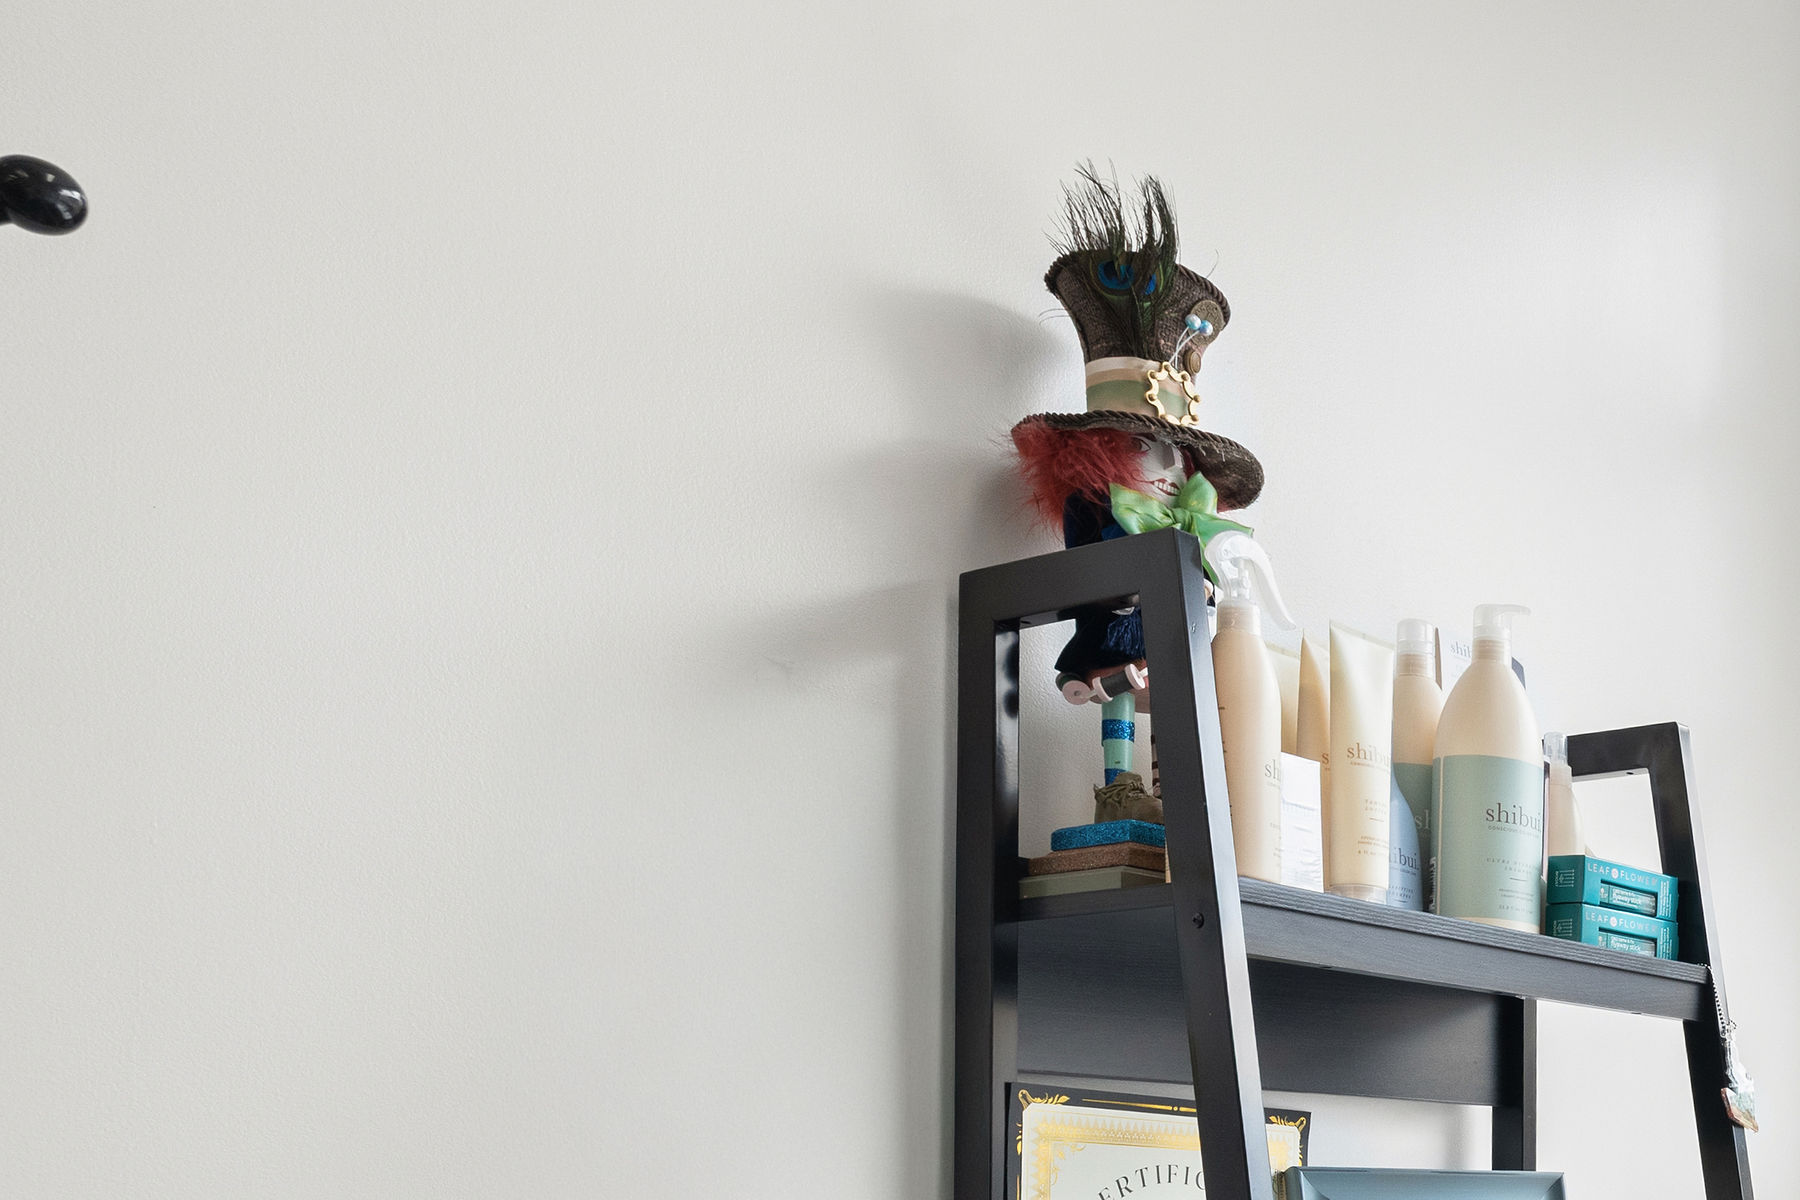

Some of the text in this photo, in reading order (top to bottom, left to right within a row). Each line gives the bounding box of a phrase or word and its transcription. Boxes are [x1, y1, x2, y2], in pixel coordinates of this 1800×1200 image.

[1587, 863, 1658, 886] LEAF FLOWER
[1585, 912, 1658, 933] LEAF FLOWER
